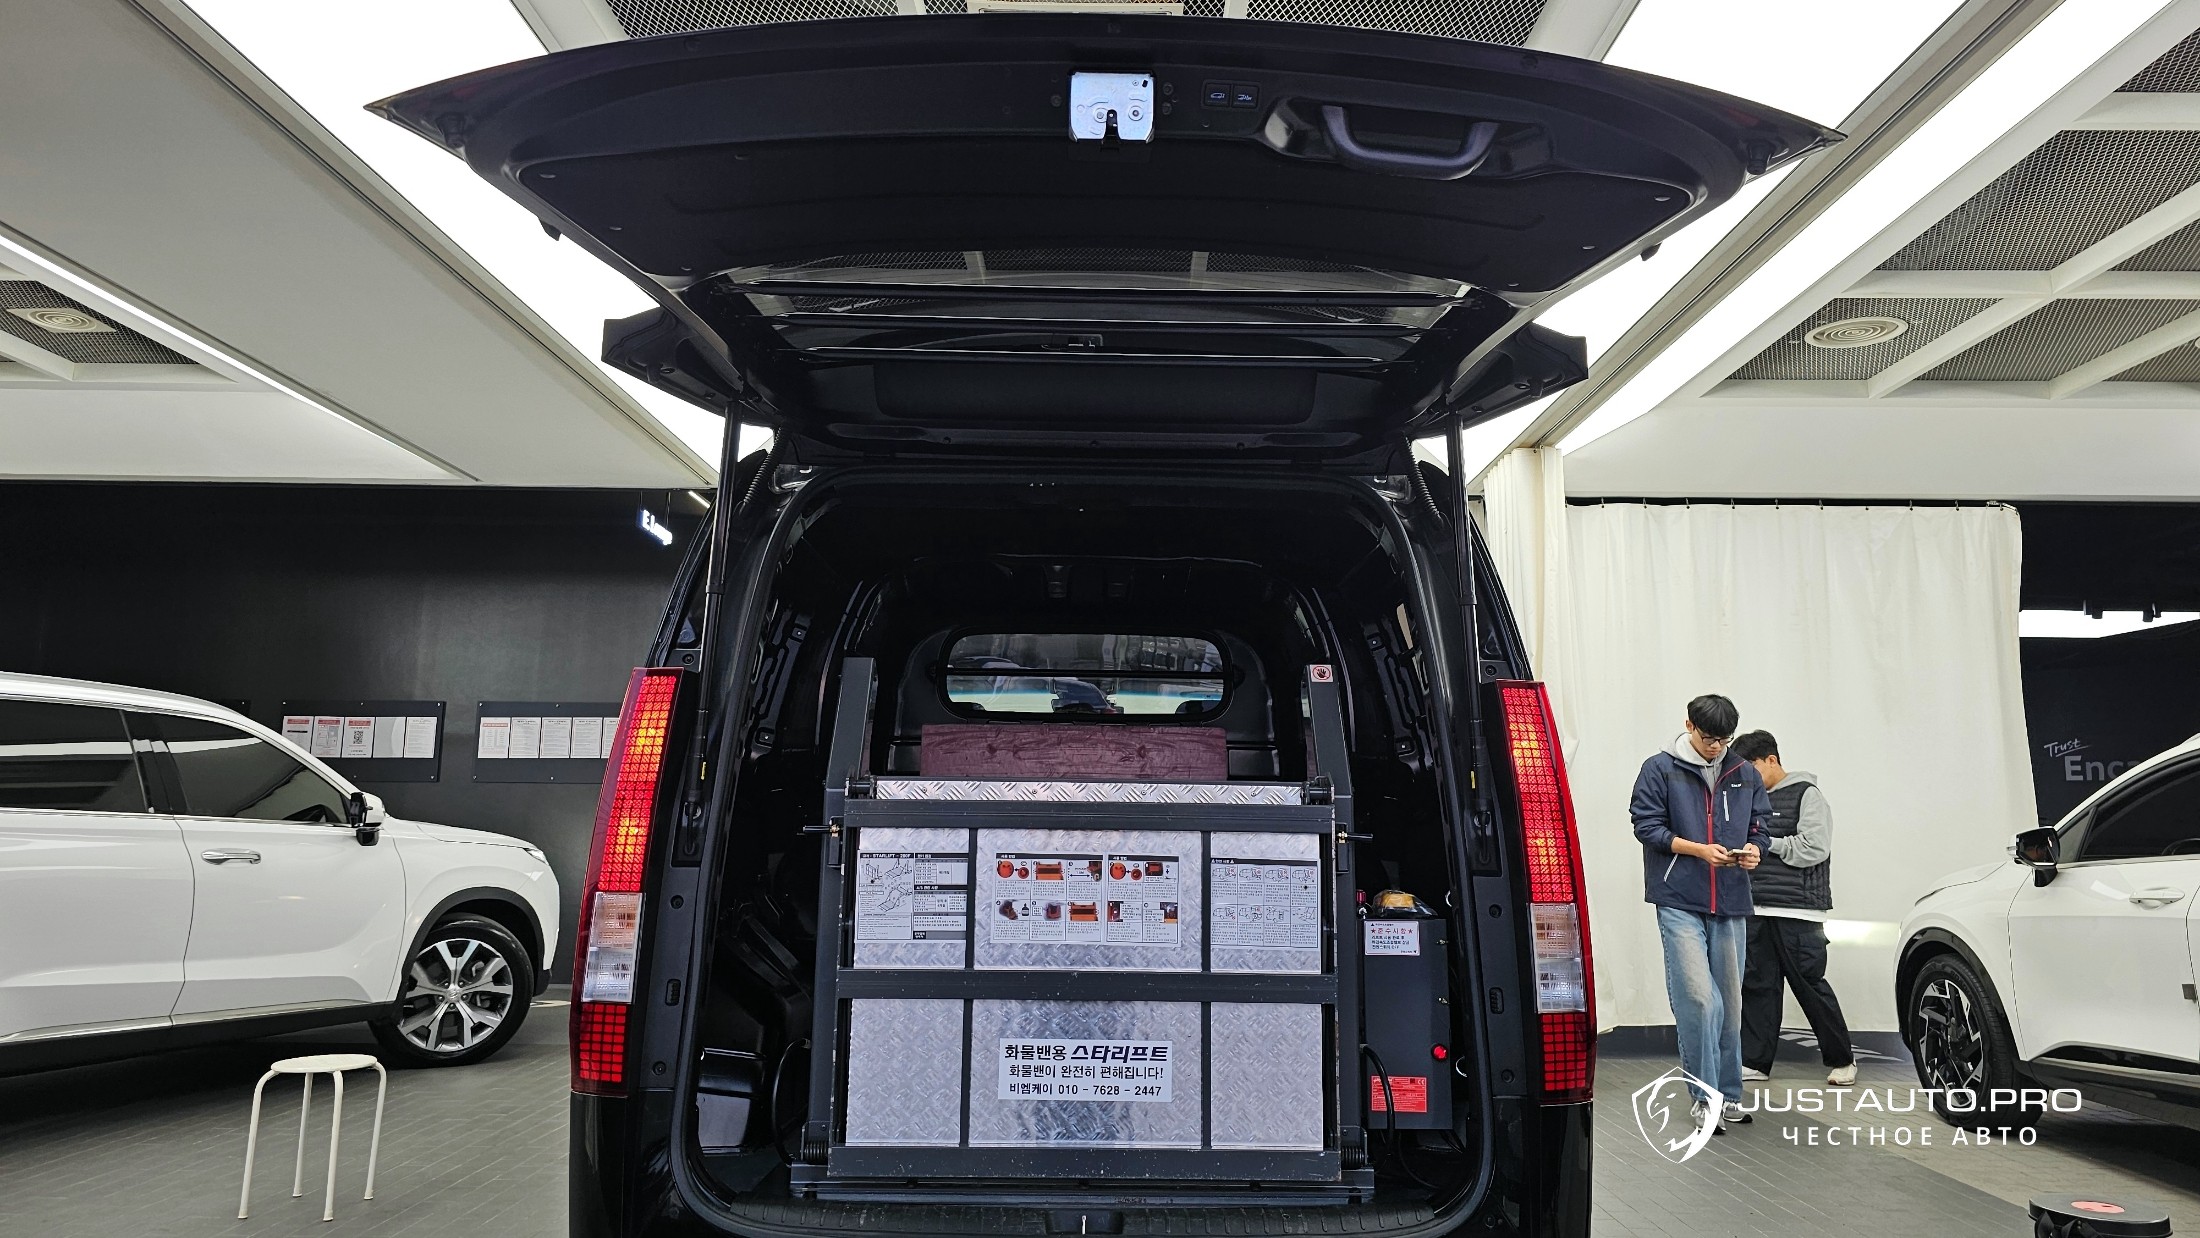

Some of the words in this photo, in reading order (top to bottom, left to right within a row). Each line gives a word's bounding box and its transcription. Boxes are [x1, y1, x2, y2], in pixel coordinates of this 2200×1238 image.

[2044, 738, 2081, 757] Trust
[1004, 1044, 1067, 1061] 화물밴용
[1070, 1045, 1168, 1063] 스타리프트
[1009, 1064, 1056, 1078] 화물밴이
[1060, 1065, 1096, 1079] 완전히
[1100, 1066, 1164, 1080] 편해집니다!
[1009, 1082, 1053, 1095] 비엠케이
[1058, 1084, 1078, 1095] 010
[1093, 1085, 1120, 1096] 7628
[1134, 1085, 1162, 1096] 2447
